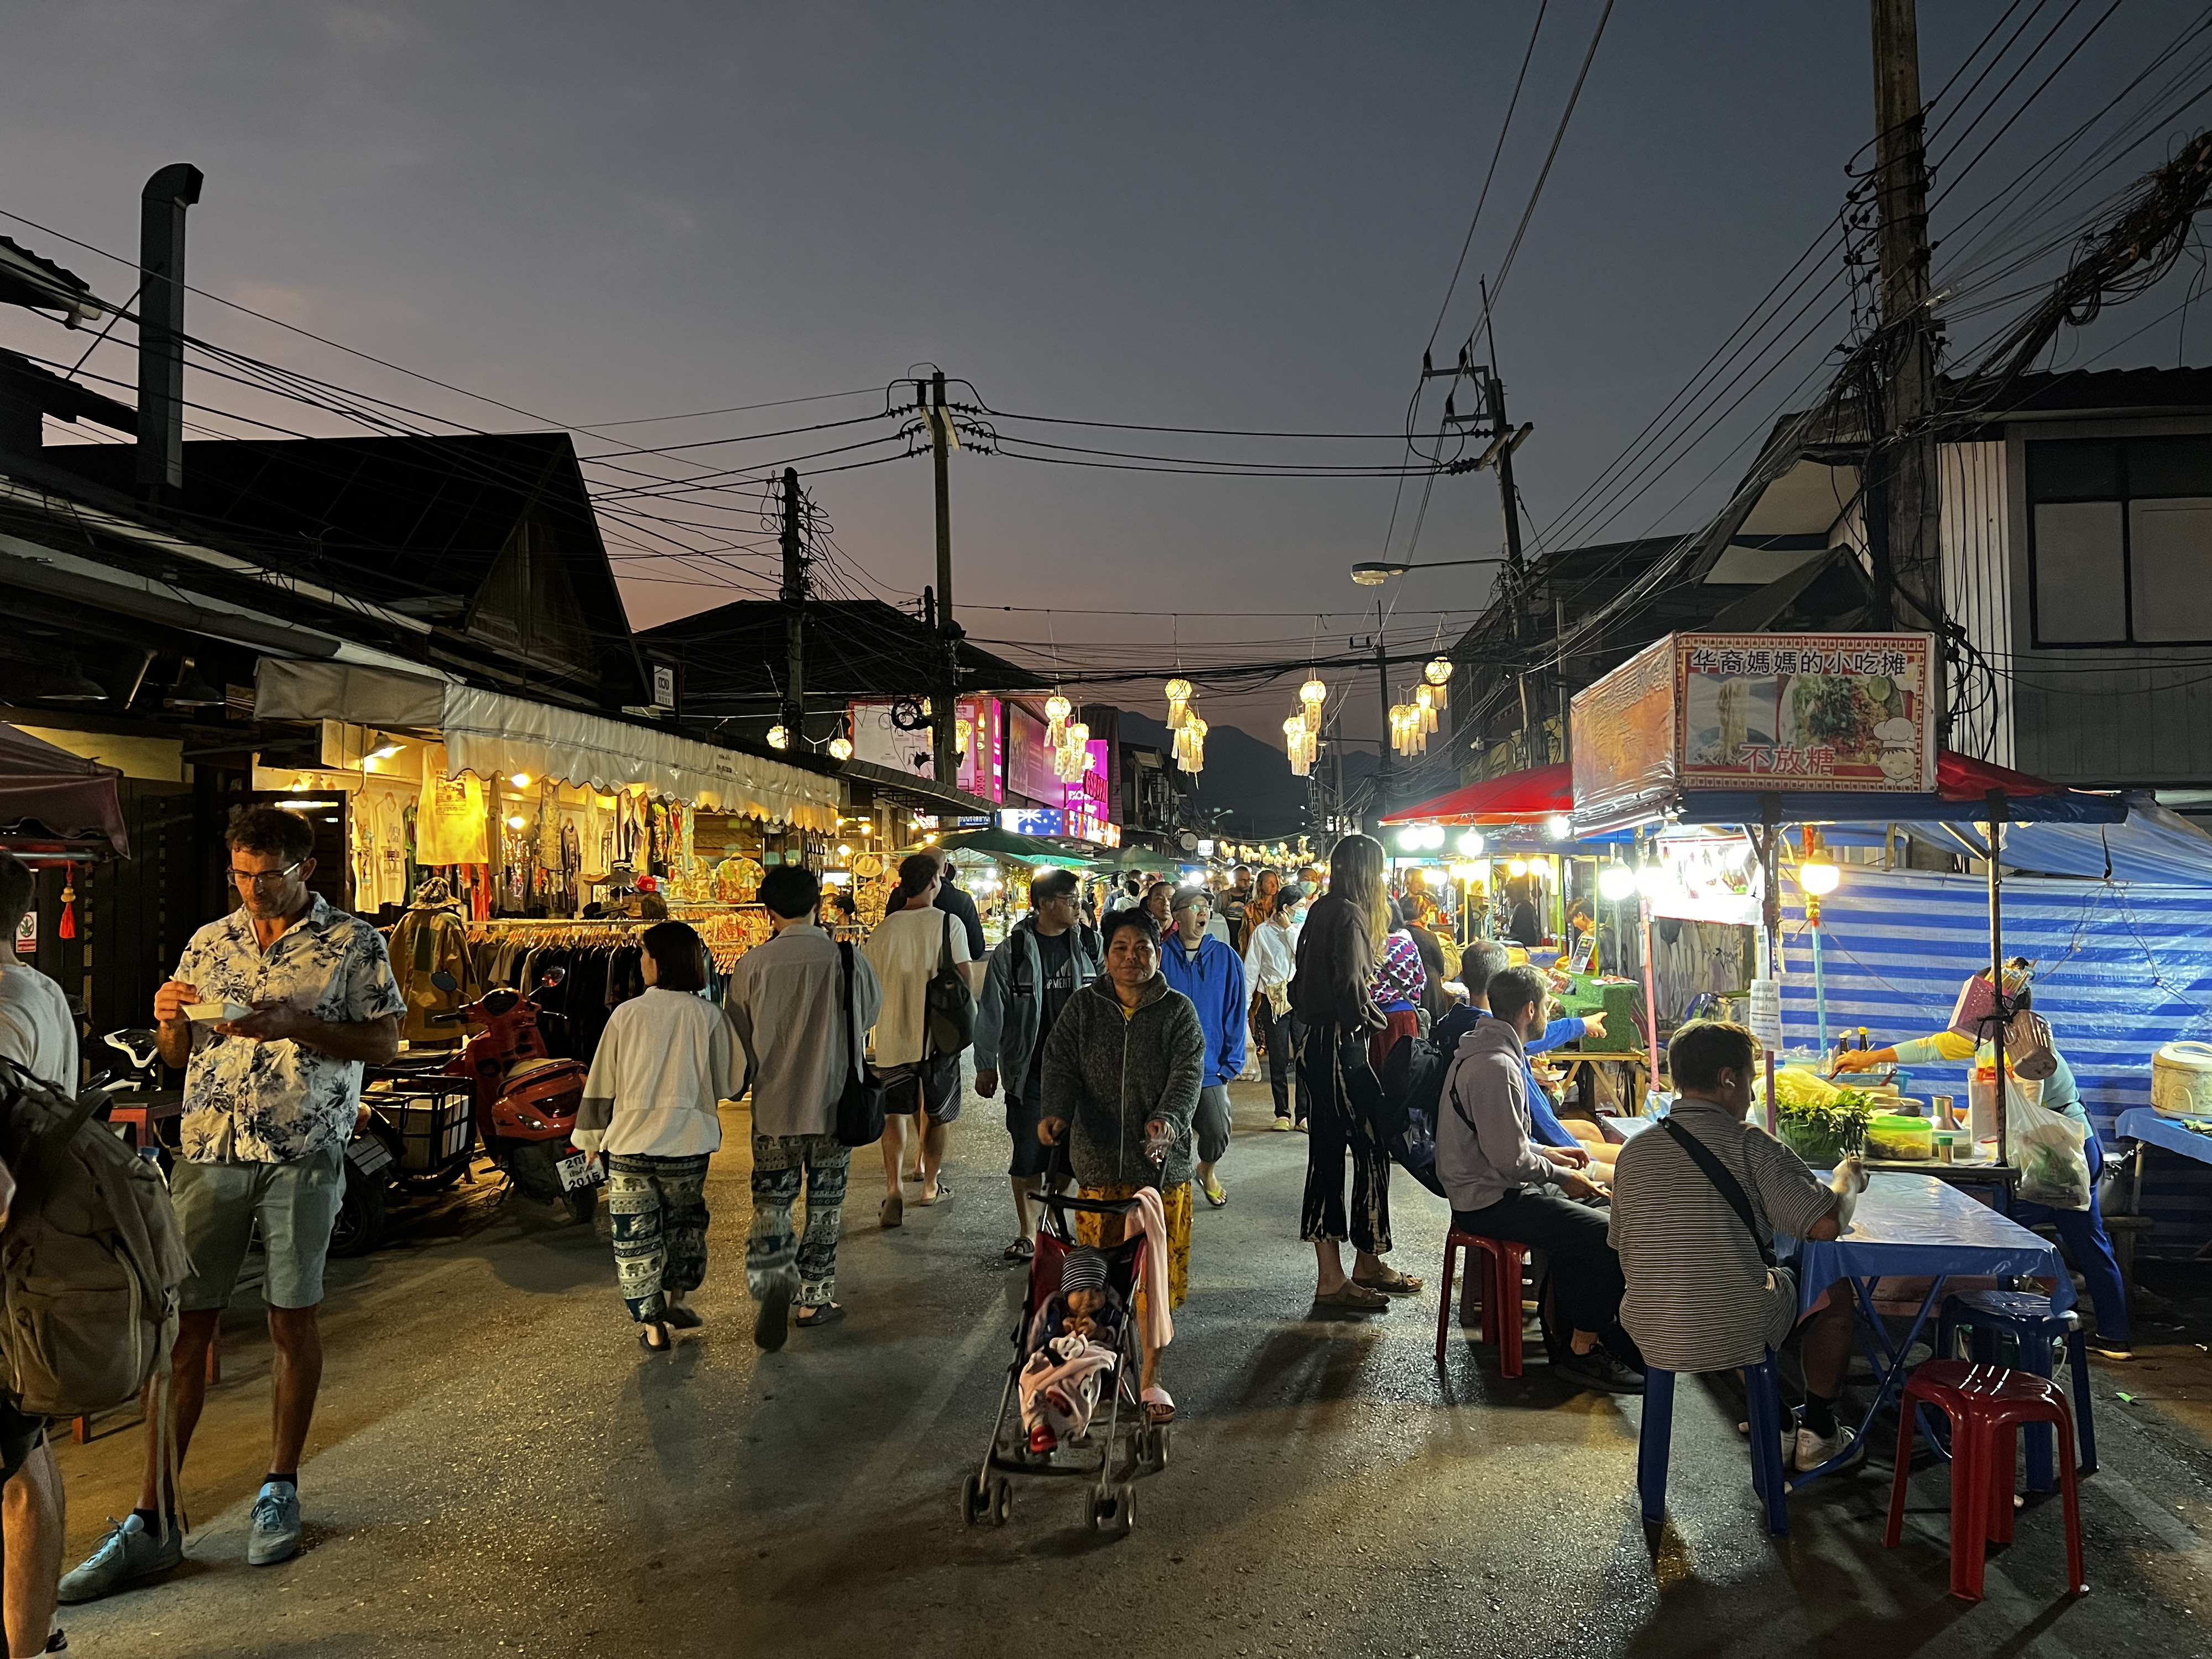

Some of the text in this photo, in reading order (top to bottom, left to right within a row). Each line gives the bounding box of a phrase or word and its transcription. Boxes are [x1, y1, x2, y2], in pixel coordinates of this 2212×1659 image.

[1693, 649, 1906, 676] 华裔媽媽的小吃摊
[1741, 745, 1835, 774] 不放糖
[568, 1171, 600, 1190] 2015
